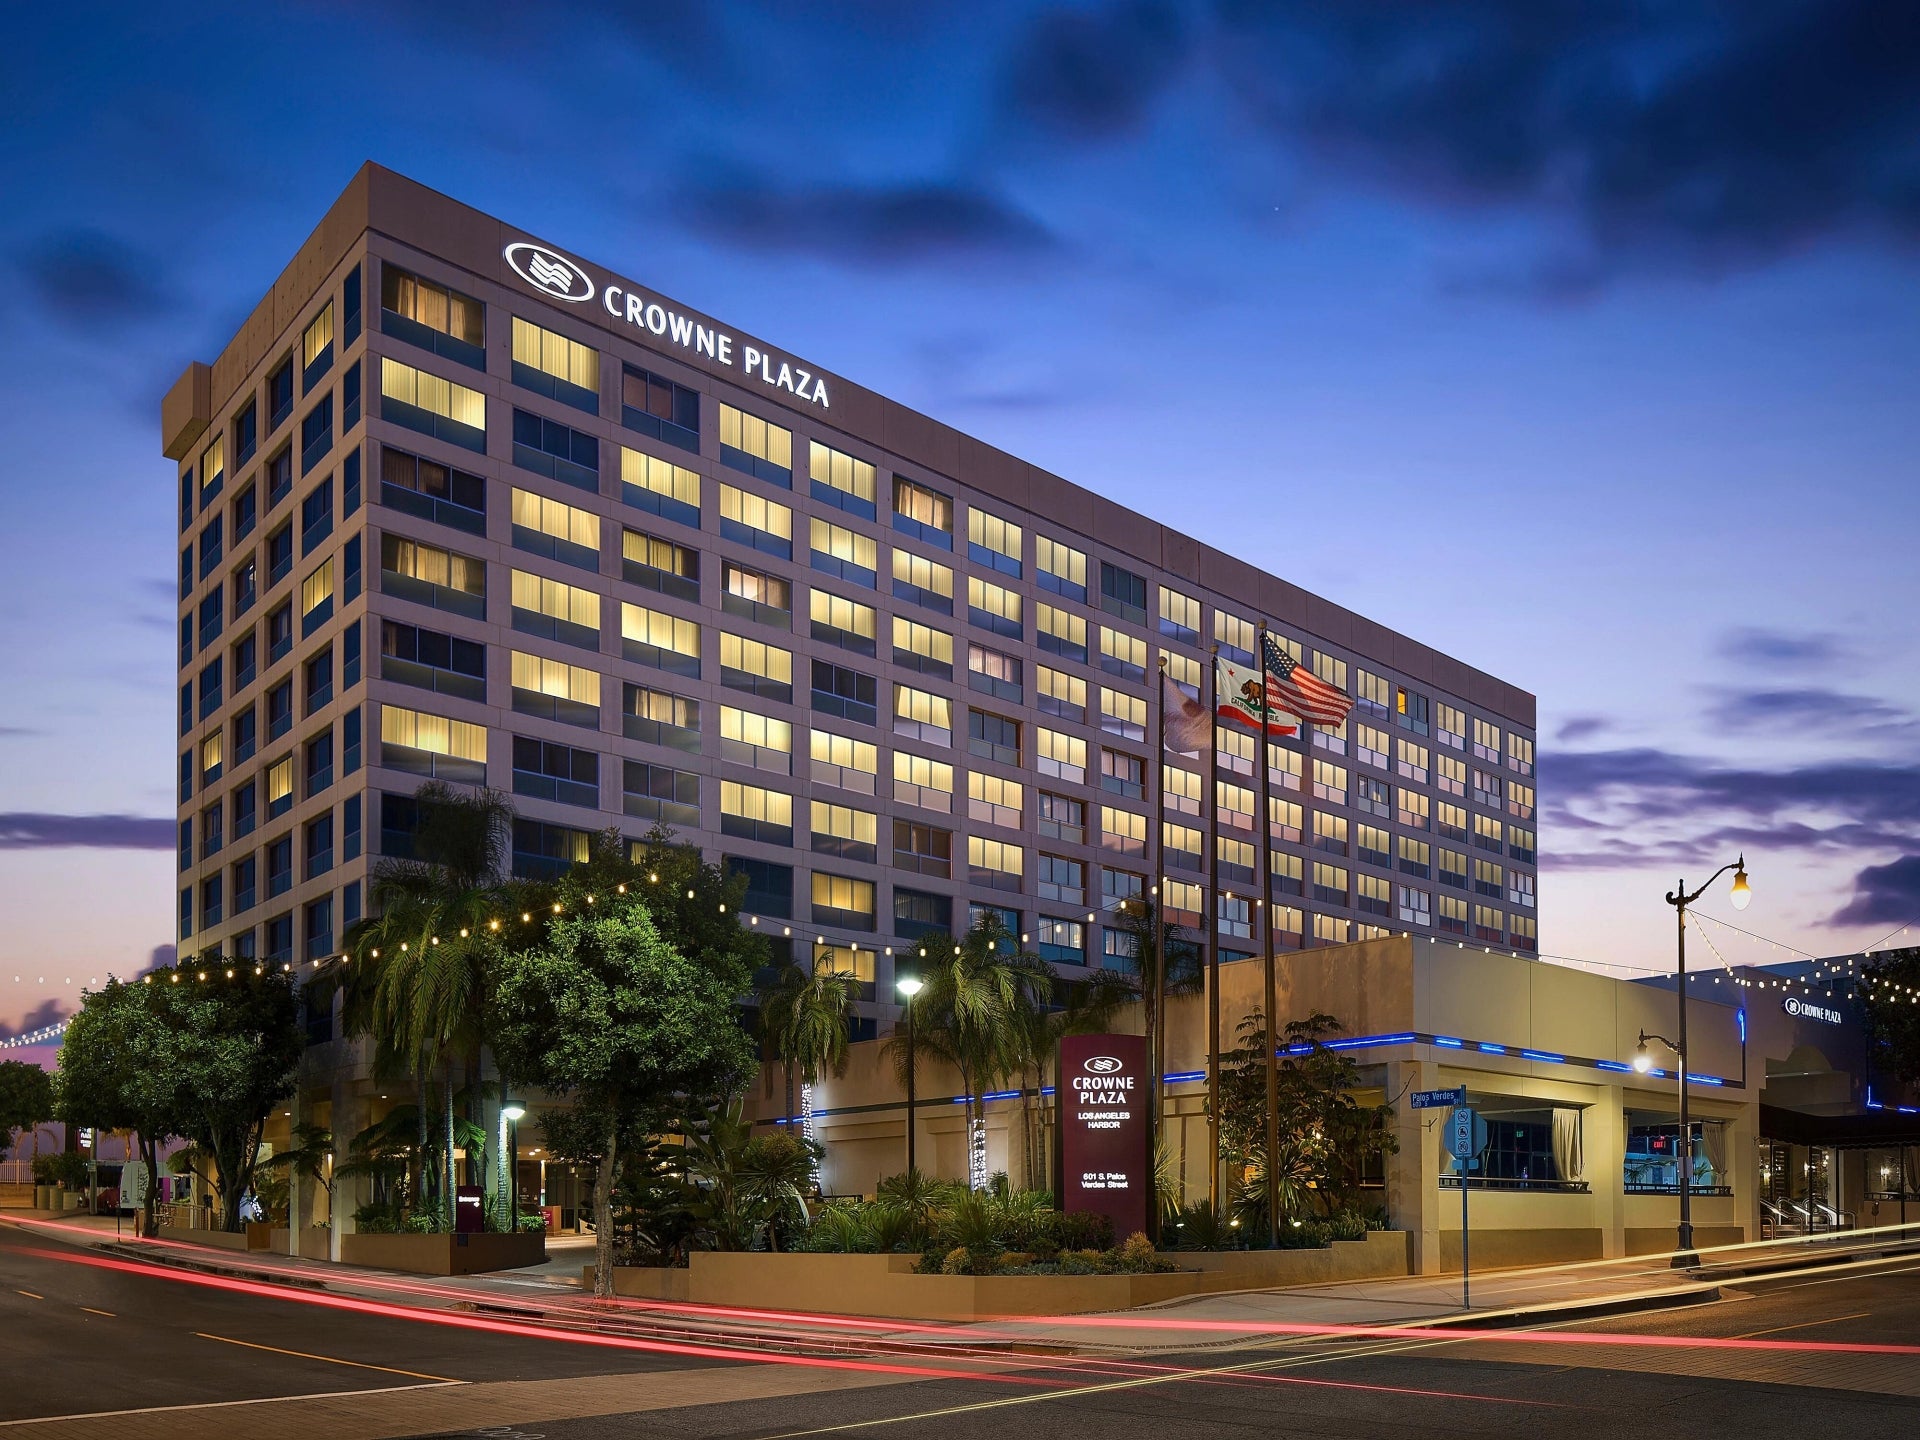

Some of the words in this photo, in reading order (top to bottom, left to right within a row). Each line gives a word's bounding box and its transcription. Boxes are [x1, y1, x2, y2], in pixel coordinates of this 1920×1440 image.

[603, 285, 733, 366] CROWNE
[744, 346, 830, 408] PLAZA
[1801, 1003, 1824, 1020] CROWNE
[1824, 1008, 1842, 1024] PLAZA
[1072, 1076, 1135, 1090] CROWNE
[1080, 1091, 1127, 1104] PLAZA
[1412, 1093, 1429, 1102] Palos
[1432, 1091, 1455, 1101] Verdes
[1077, 1112, 1093, 1120] LOS
[1094, 1112, 1131, 1120] ANGELES
[1087, 1121, 1121, 1129] HARBOR
[1083, 1172, 1097, 1180] 601
[1098, 1172, 1106, 1180] S.
[1106, 1172, 1127, 1180] Palos
[1081, 1181, 1106, 1189] Verdes
[1107, 1181, 1129, 1189] Street
